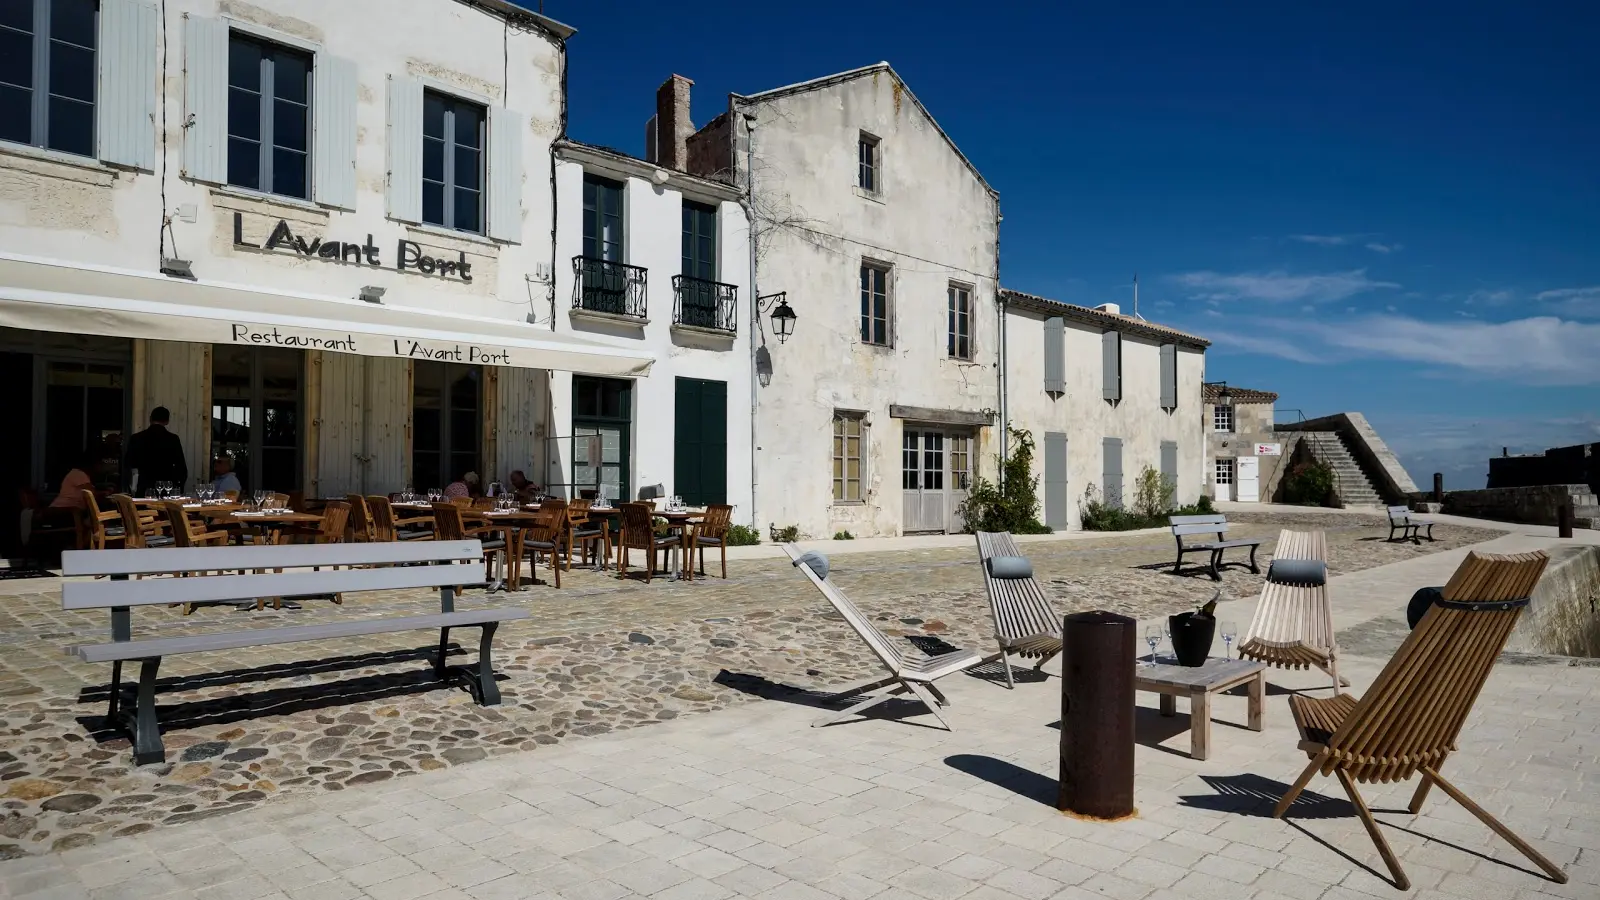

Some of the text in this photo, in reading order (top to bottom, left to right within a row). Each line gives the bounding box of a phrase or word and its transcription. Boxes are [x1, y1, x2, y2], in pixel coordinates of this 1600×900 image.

[397, 239, 473, 281] Port
[231, 323, 511, 365] Restaurant L'Avant Port
